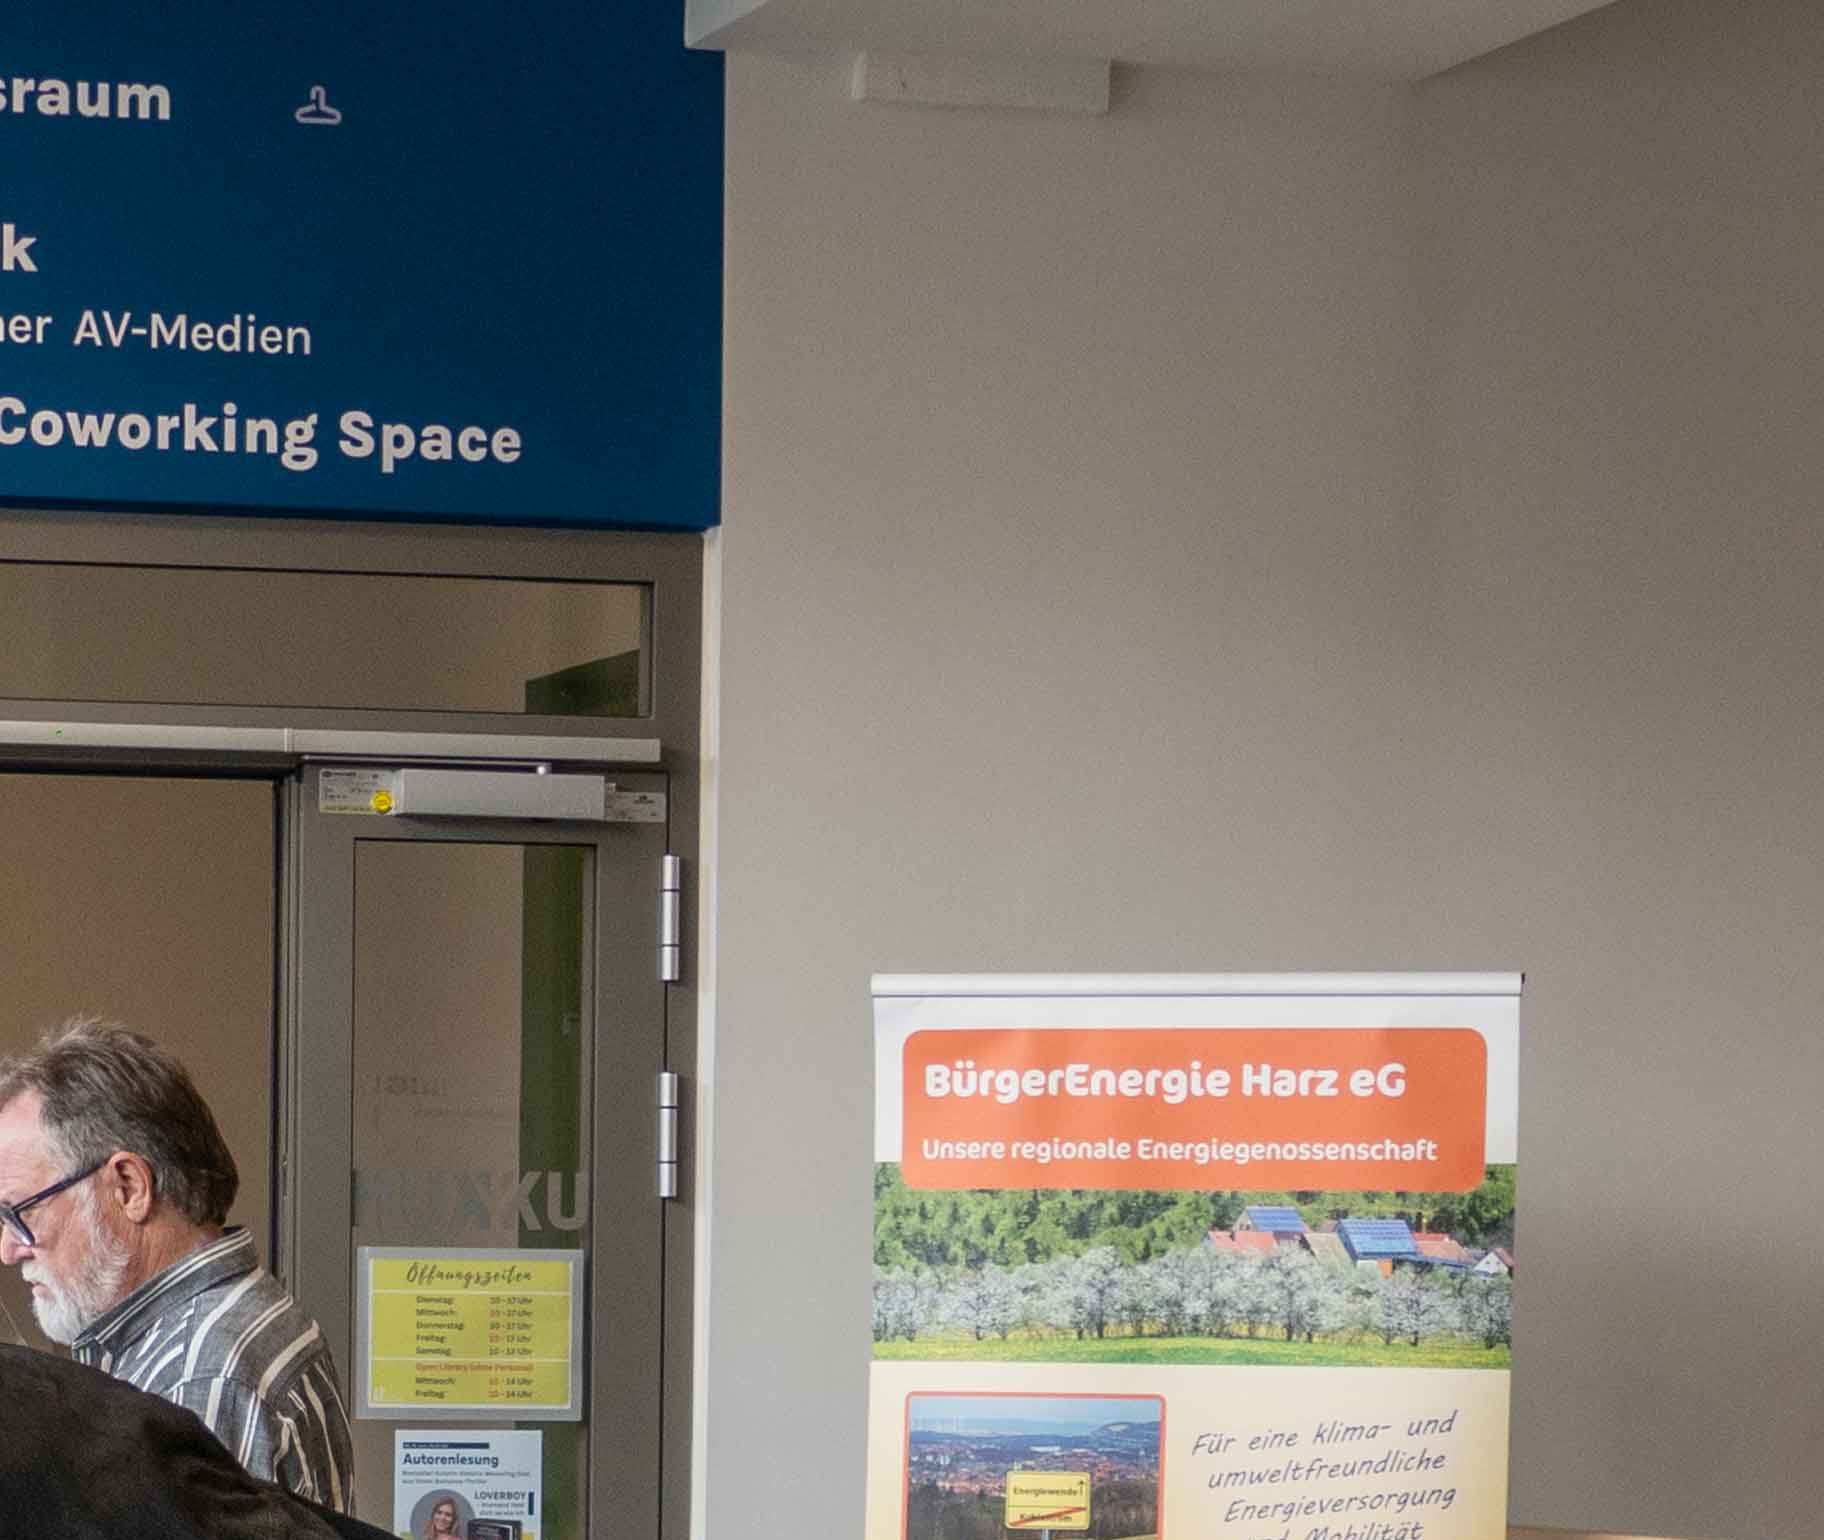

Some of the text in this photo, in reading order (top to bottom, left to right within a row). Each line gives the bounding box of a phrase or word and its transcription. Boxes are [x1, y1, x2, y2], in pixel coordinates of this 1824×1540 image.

[74, 310, 310, 354] AV-Medien
[339, 411, 520, 472] Space
[926, 1060, 1405, 1104] BürgerEnergie Harz eG
[923, 1138, 1437, 1165] Unsere regionale Energiegenossenschaft
[406, 1262, 532, 1288] Öffnungszeiten
[1192, 1409, 1458, 1456] Für eine klima- und
[403, 1453, 499, 1468] Autorenlesung
[1208, 1448, 1446, 1488] umweltfreundliche
[474, 1490, 527, 1501] LOVERBOY
[1224, 1488, 1456, 1527] Energieversorgung
